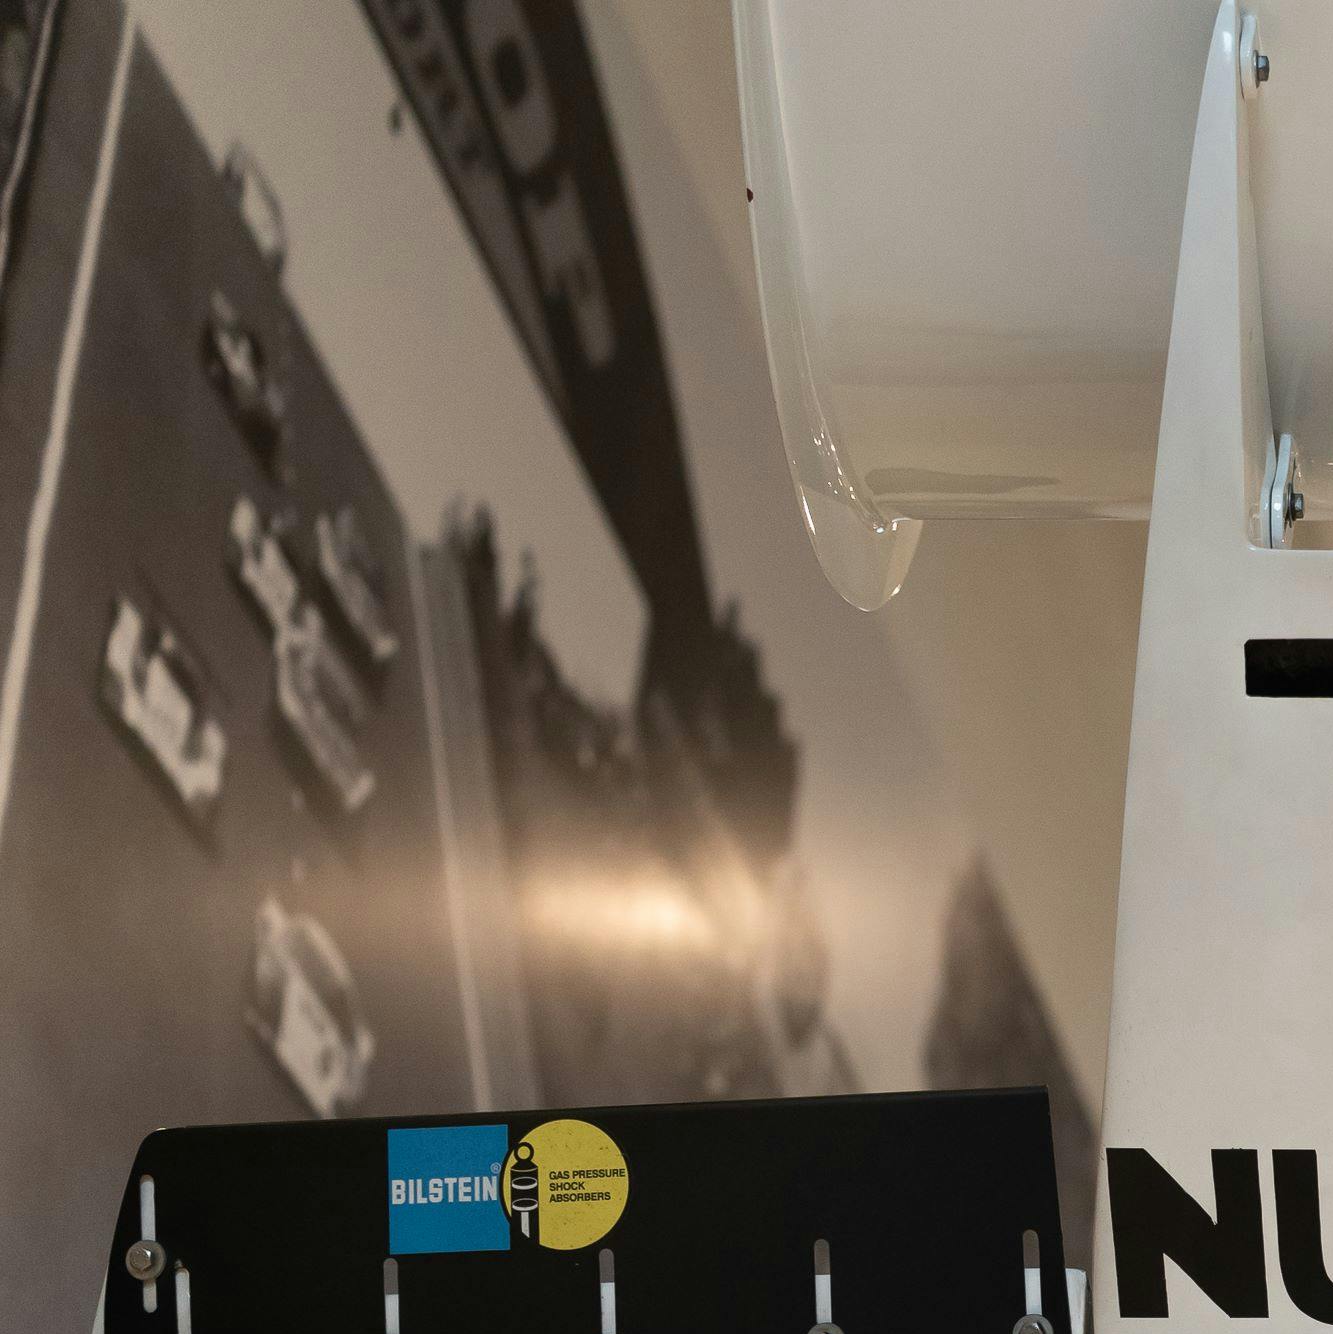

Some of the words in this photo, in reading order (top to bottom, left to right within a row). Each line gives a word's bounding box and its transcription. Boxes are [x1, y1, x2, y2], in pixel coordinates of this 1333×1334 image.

[548, 1170, 570, 1181] GAS
[572, 1167, 627, 1180] PRESSURE
[391, 1175, 498, 1206] BILSTEIN
[548, 1181, 586, 1192] SHOCK
[548, 1190, 612, 1203] ABSORBERS
